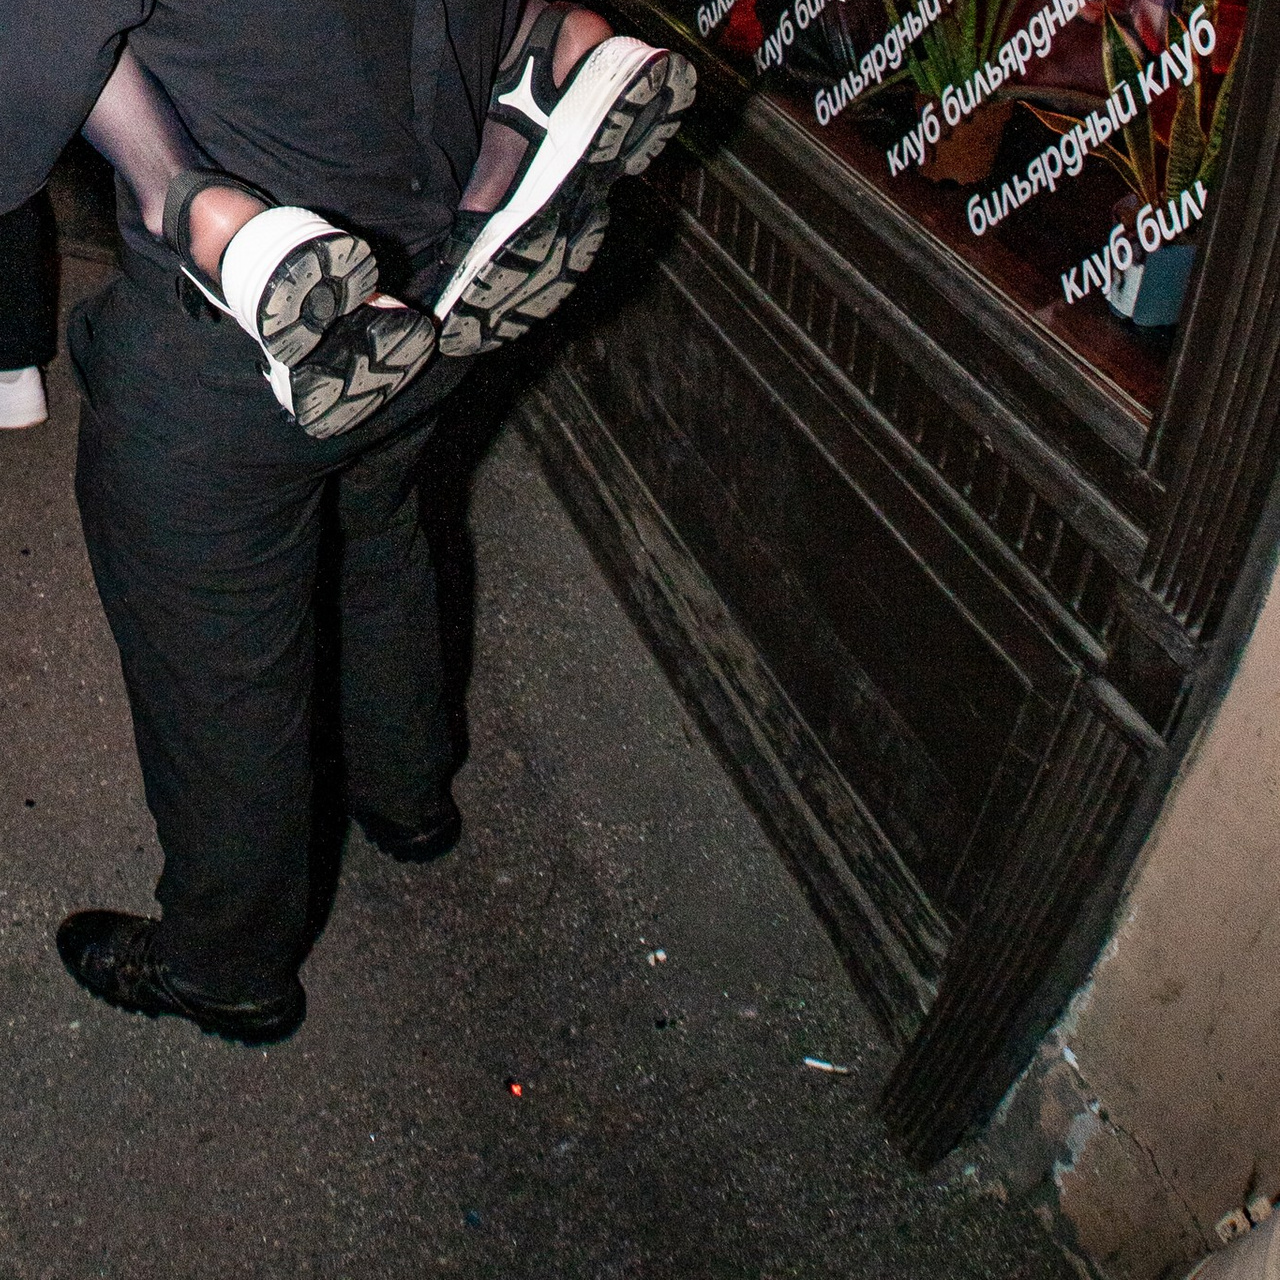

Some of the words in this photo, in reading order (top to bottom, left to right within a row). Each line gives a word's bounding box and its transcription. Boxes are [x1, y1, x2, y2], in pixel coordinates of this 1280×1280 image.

[754, 9, 795, 76] клуб
[886, 102, 941, 178] клуб
[966, 79, 1138, 237] бильярдный
[1136, 3, 1217, 106] клуб
[1060, 222, 1134, 306] клуб
